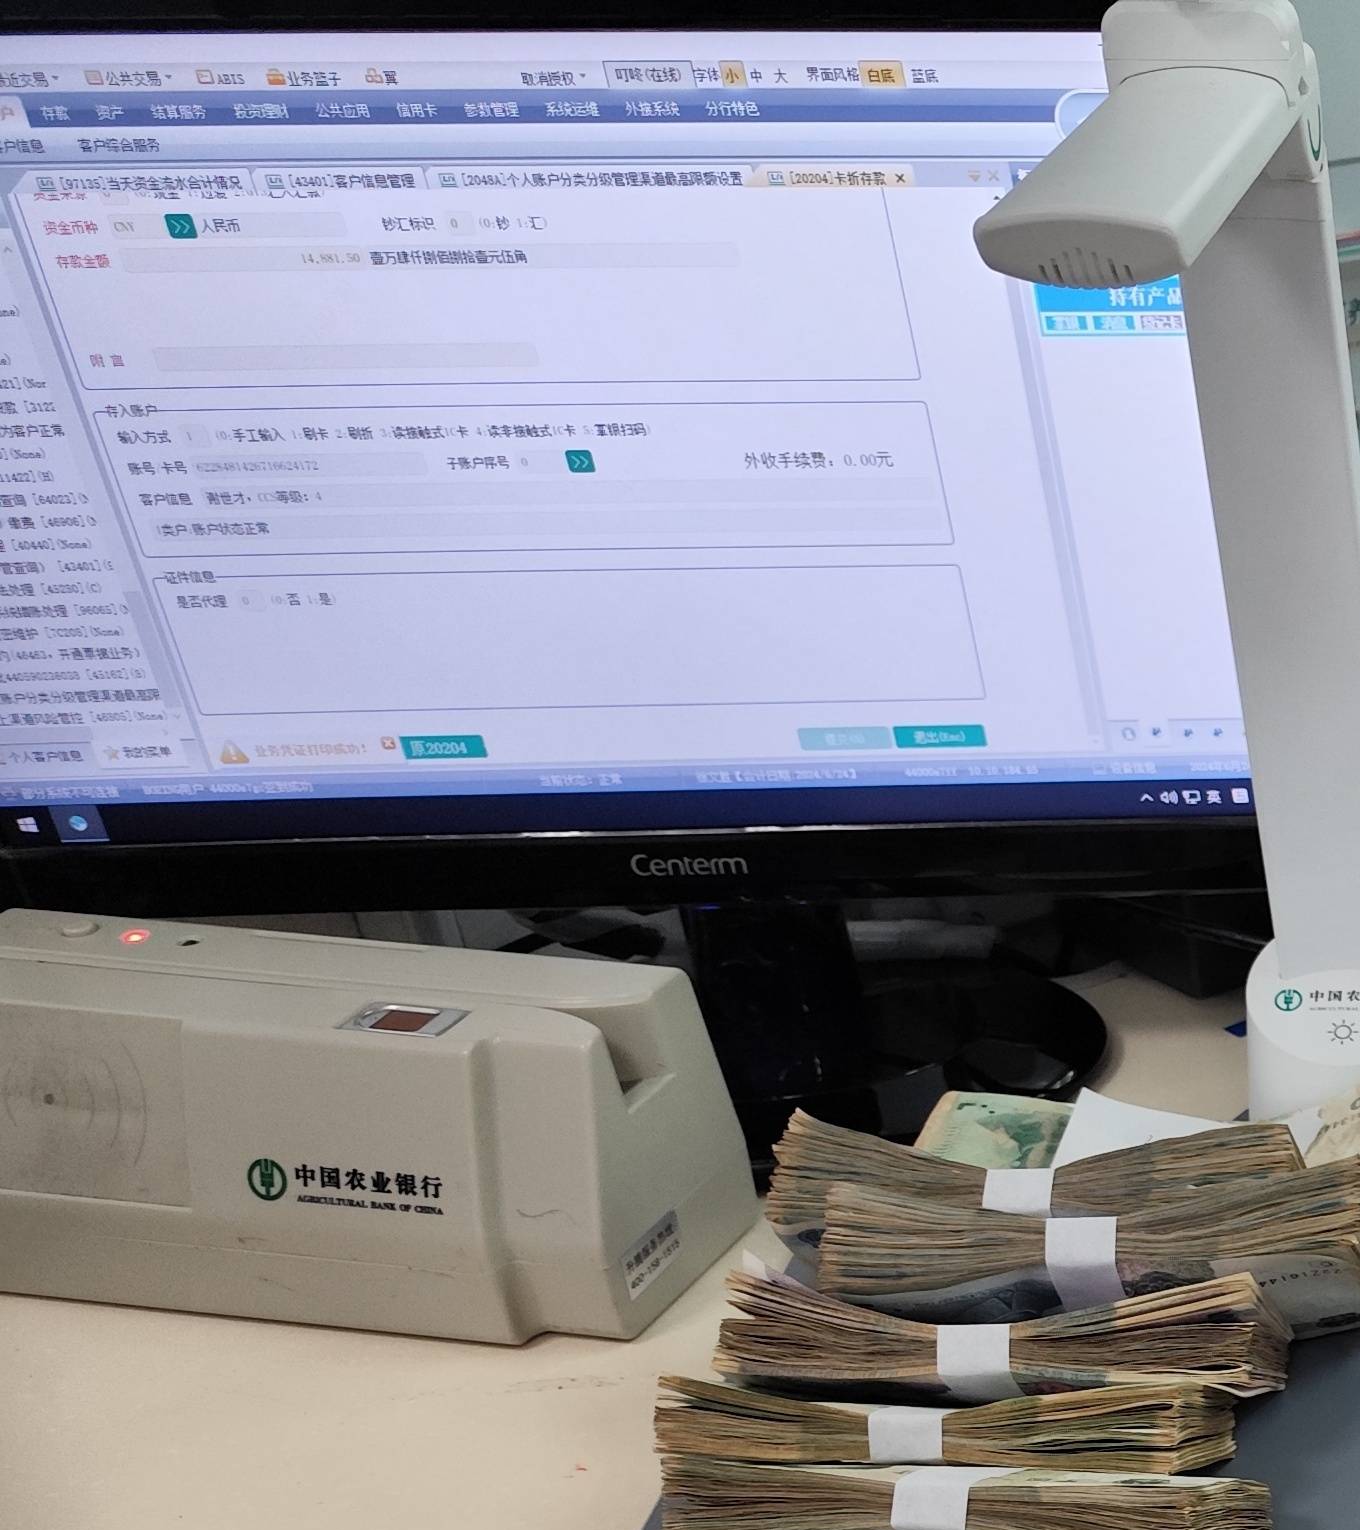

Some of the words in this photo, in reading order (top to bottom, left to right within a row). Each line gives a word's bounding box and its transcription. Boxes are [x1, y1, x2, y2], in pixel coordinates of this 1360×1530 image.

[105, 70, 162, 87] 公共交易
[217, 73, 245, 86] ABIS
[287, 70, 342, 87] 业务篮子
[521, 71, 576, 87] 取消授权
[692, 67, 720, 82] 字体
[725, 68, 740, 84] 小
[750, 68, 763, 83] 中
[773, 69, 789, 84] 大
[805, 67, 860, 83] 界面风格
[867, 68, 896, 84] 白底
[911, 68, 940, 84] 蓝底
[40, 105, 71, 121] 存款
[151, 103, 207, 120] 结算服务
[315, 102, 371, 119] 公共应用
[396, 102, 440, 118] 信用卡
[464, 102, 520, 118] 参数管理
[545, 101, 601, 117] 系统运维
[625, 101, 680, 117] 外接系统
[705, 100, 760, 117] 分行特色
[77, 137, 161, 153] 客户综合服务
[201, 218, 241, 234] 人民币
[630, 854, 750, 878] Centerm
[294, 1164, 443, 1199] 中国农业银行
[296, 1195, 368, 1209] AGRICULTURAL
[370, 1201, 396, 1211] BANK
[399, 1203, 413, 1213] OF
[414, 1205, 444, 1216] CHINA
